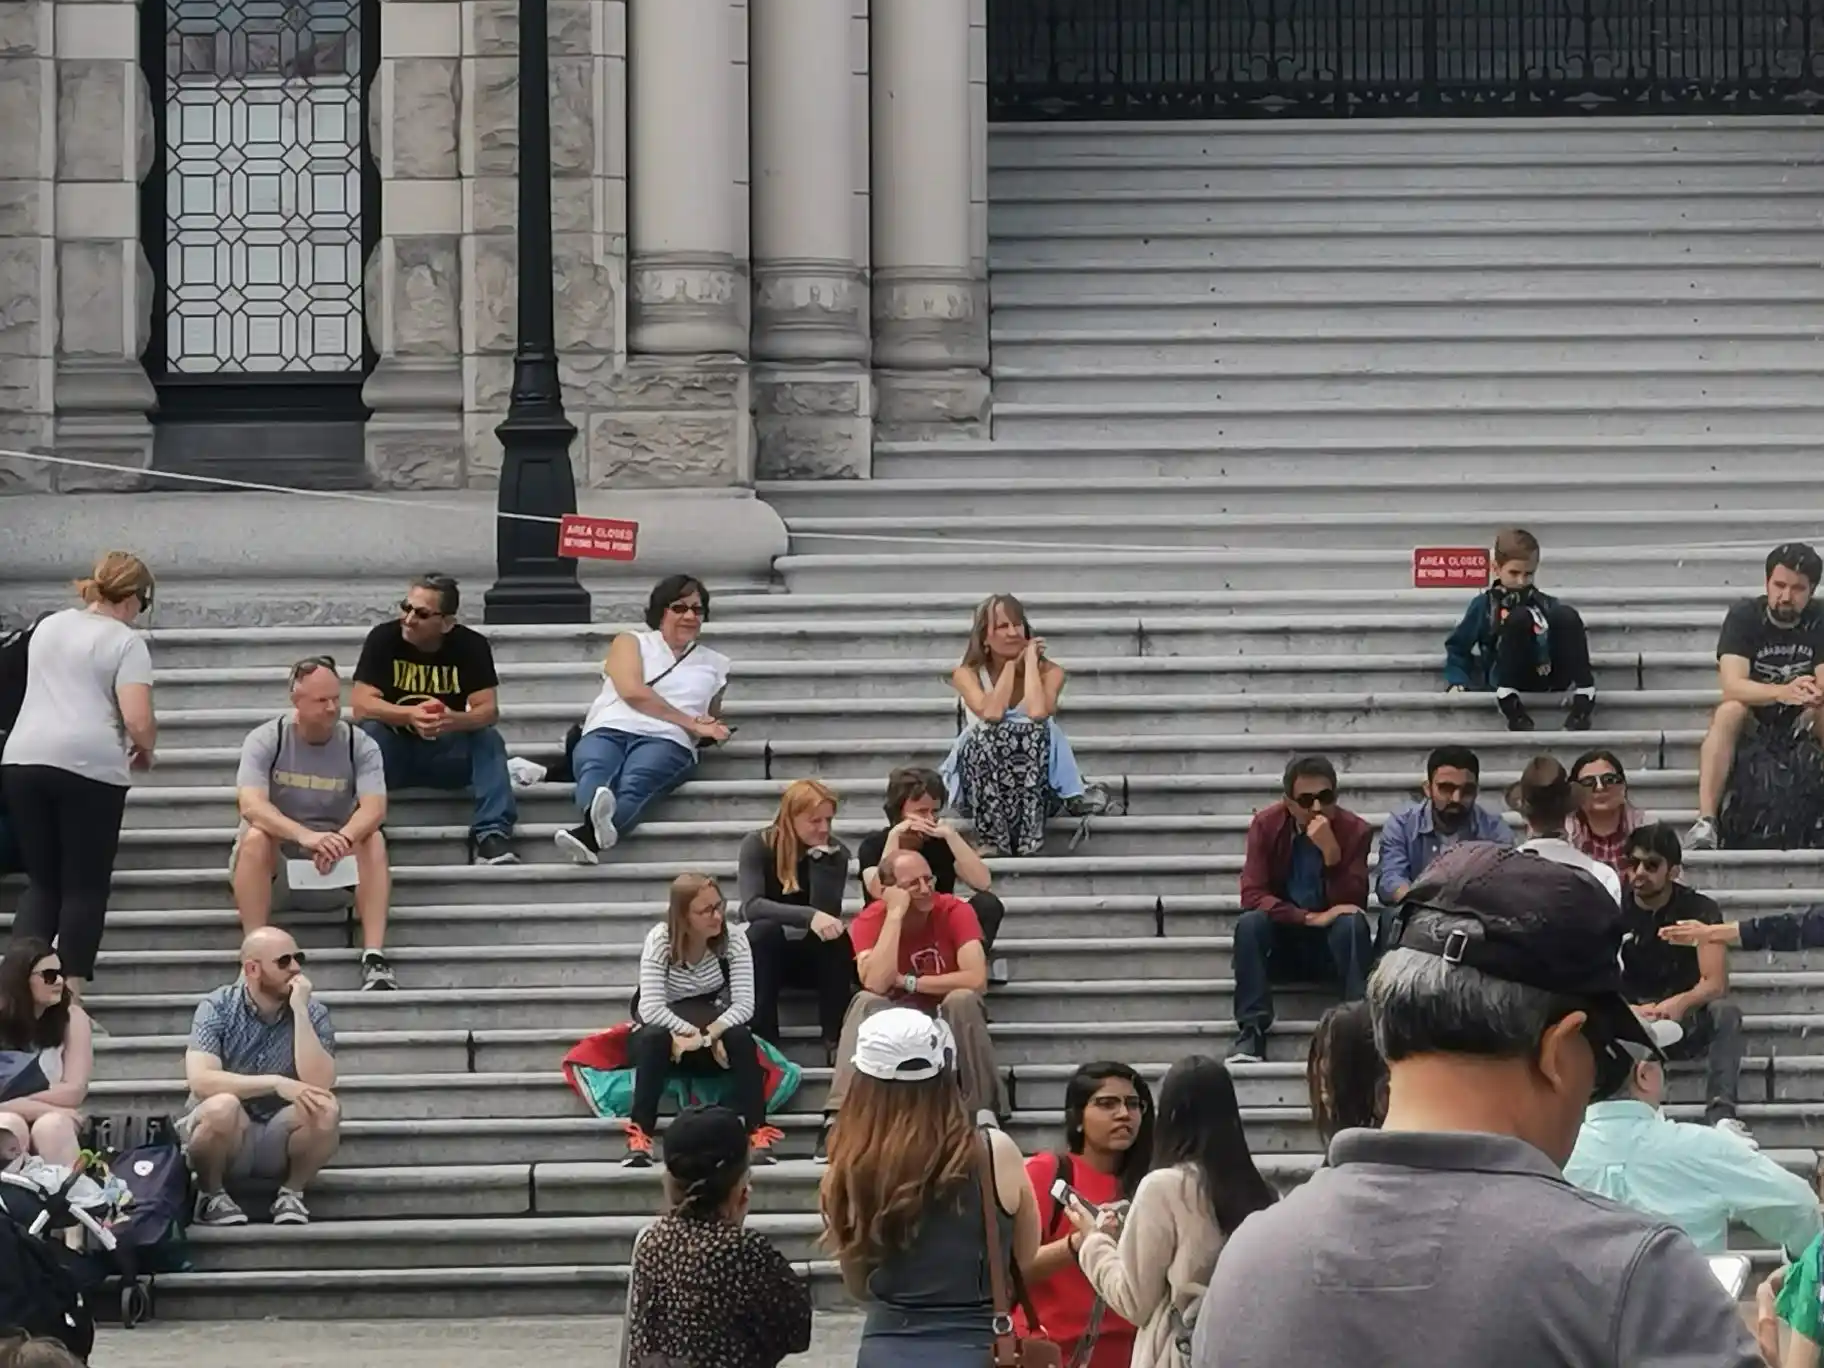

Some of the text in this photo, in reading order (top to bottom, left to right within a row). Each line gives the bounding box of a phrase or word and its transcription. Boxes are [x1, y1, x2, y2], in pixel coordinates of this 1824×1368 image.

[566, 525, 633, 540] AREA CLOSED
[1419, 555, 1486, 567] AREA CLOSED
